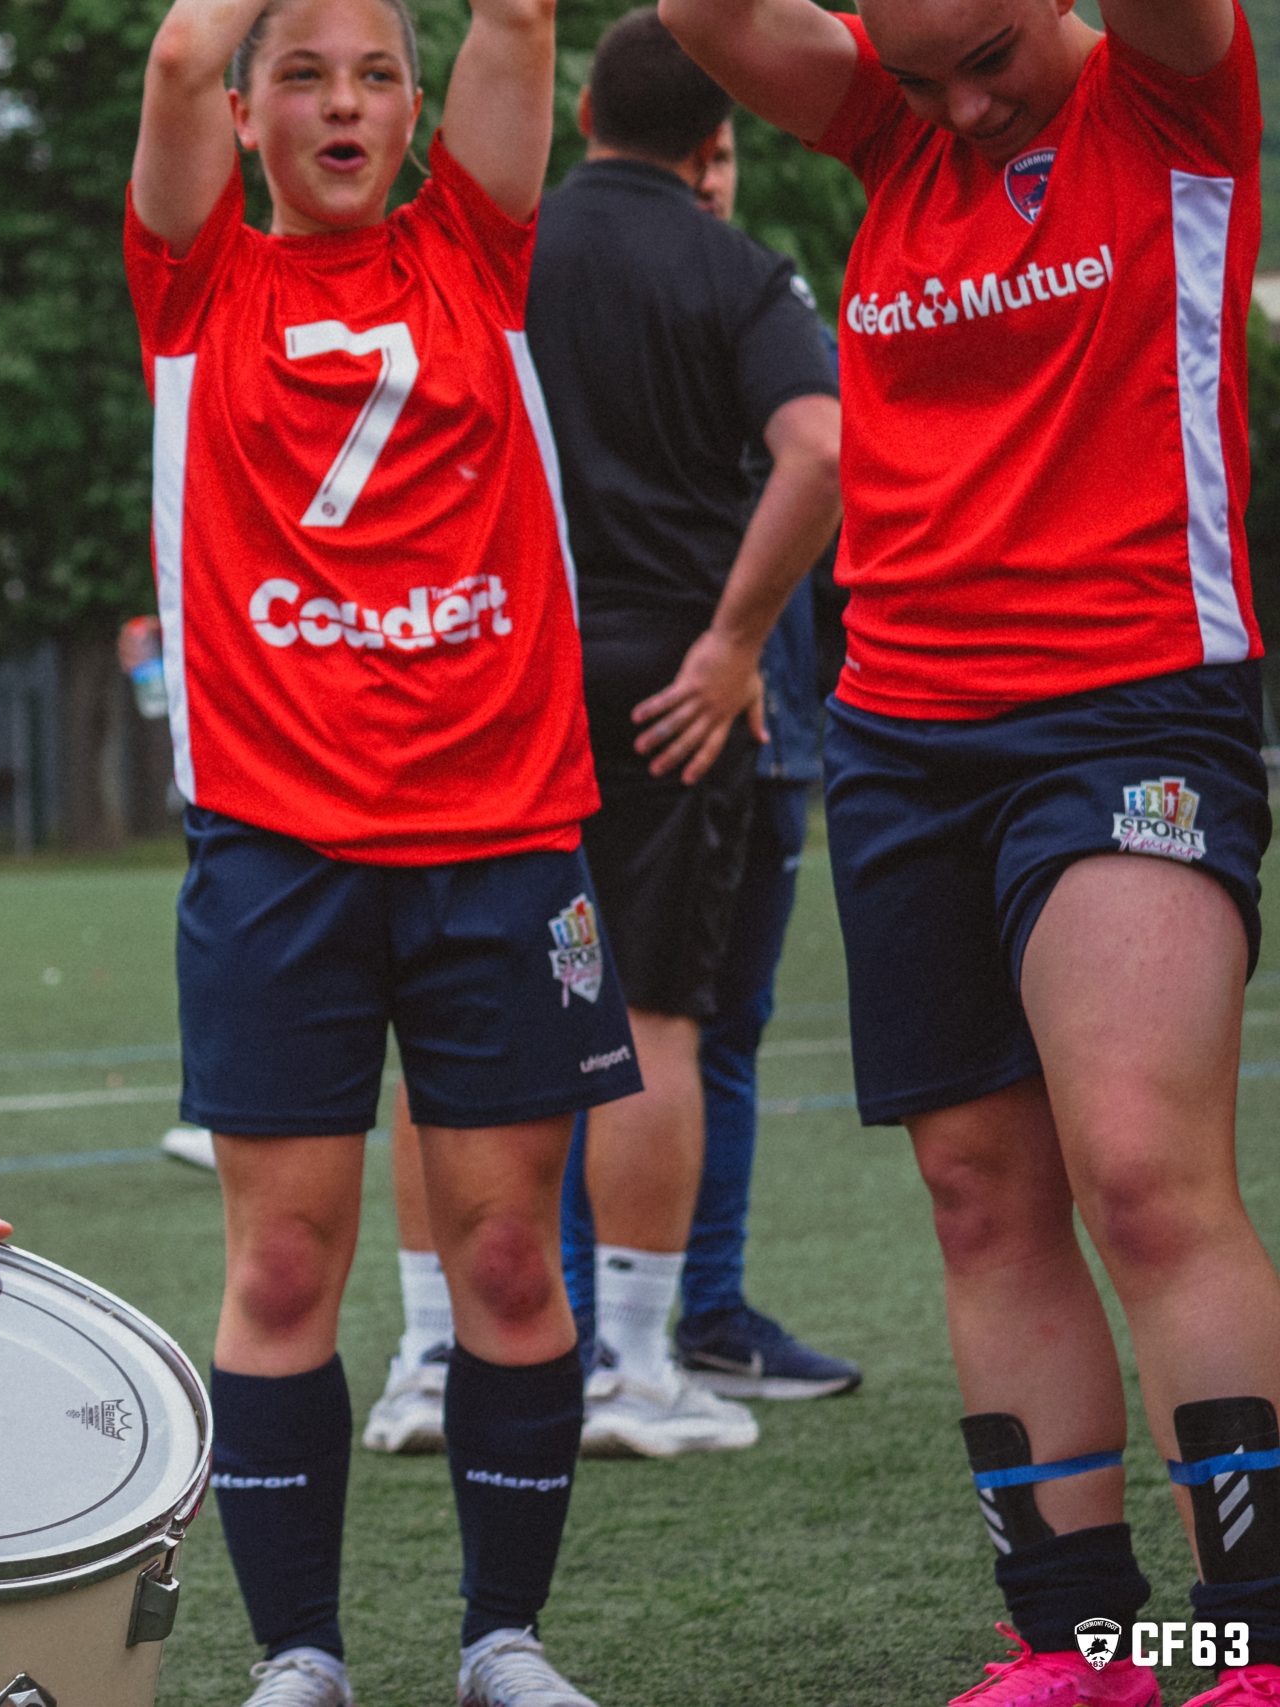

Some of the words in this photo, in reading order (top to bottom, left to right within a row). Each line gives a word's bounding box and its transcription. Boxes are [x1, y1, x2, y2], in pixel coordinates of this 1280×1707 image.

[1014, 153, 1054, 172] CLERMON
[846, 291, 916, 335] Céat
[959, 244, 1114, 321] Mutuel
[284, 319, 420, 528] 7
[249, 574, 513, 650] Coudert
[1120, 818, 1200, 848] SPORT
[105, 1403, 116, 1435] REMO
